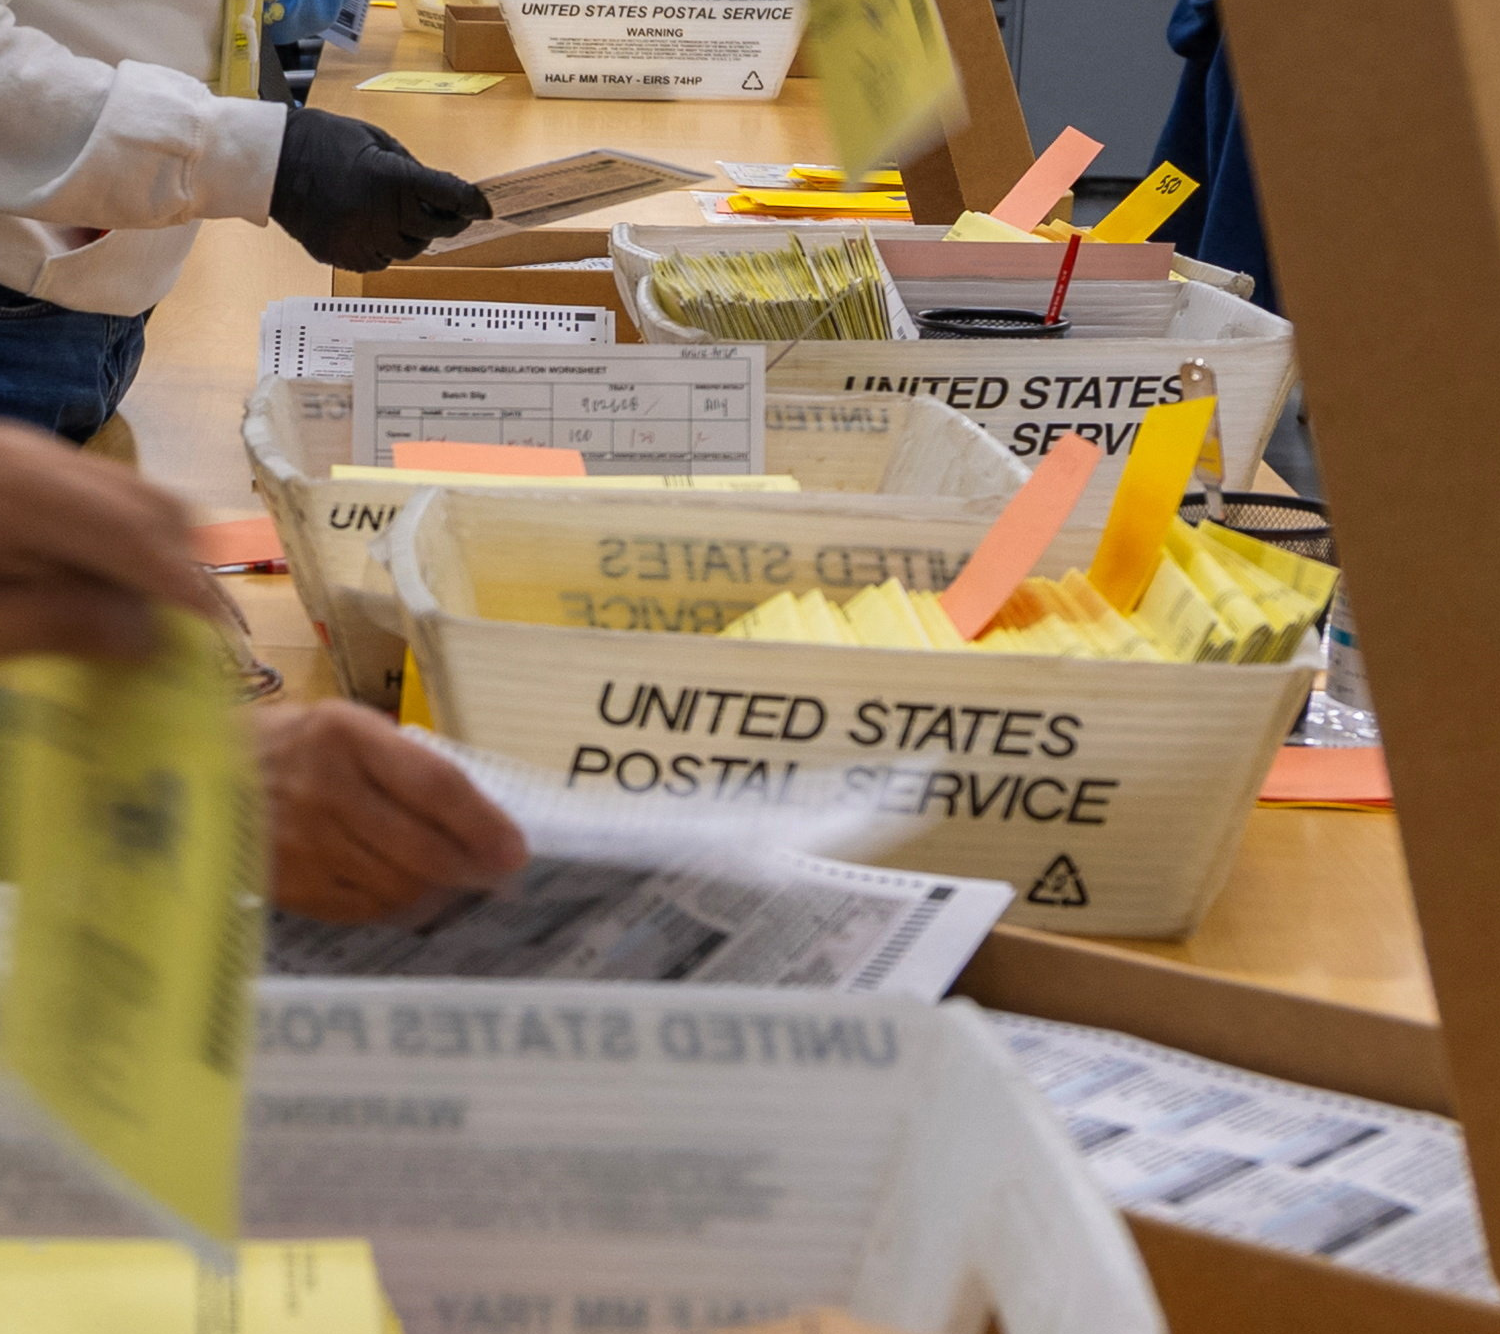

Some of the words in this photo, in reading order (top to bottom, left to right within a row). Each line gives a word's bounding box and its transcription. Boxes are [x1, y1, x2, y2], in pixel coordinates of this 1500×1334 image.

[521, 3, 580, 17] UNITED
[585, 5, 647, 19] STATES
[652, 6, 717, 19] POSTAL
[722, 7, 794, 20] SERVICE
[627, 27, 684, 38] WARNING
[545, 74, 576, 83] HALF
[579, 74, 598, 84] MM
[602, 75, 633, 85] TRAY
[643, 75, 670, 85] EIRS
[674, 76, 702, 86] 74HP
[1156, 175, 1182, 194] 550
[549, 365, 607, 375] WORKSHEET
[1020, 375, 1183, 409] STATES
[597, 681, 827, 743] UNITED
[846, 699, 1083, 758] STATES
[565, 746, 798, 807] POSTAL
[832, 765, 1119, 825] SERVICE
